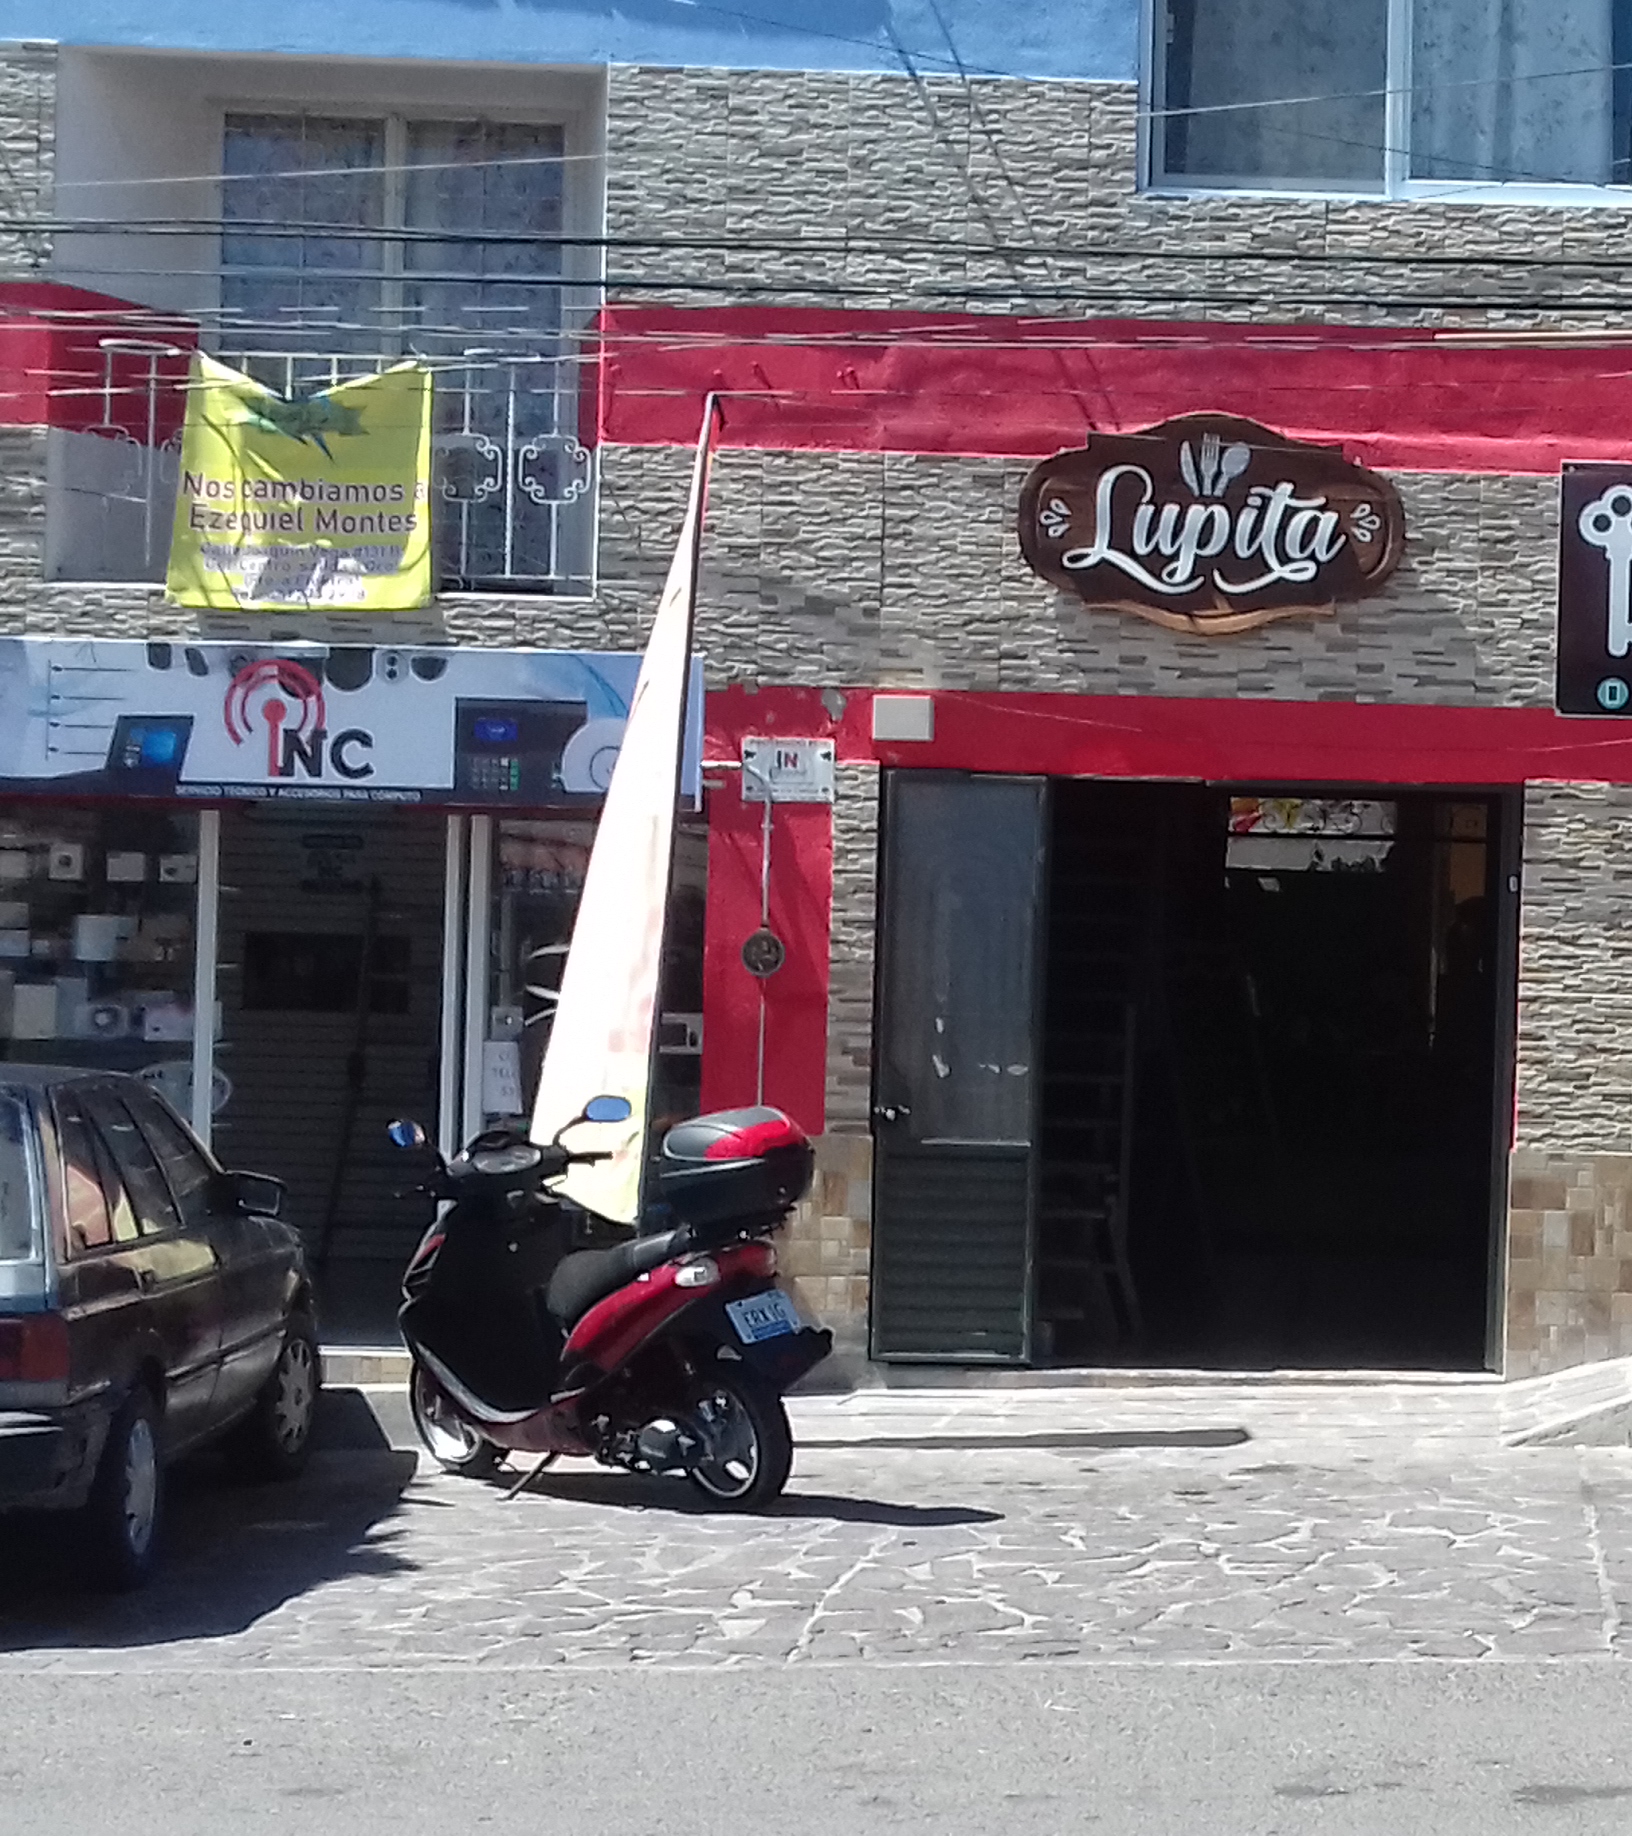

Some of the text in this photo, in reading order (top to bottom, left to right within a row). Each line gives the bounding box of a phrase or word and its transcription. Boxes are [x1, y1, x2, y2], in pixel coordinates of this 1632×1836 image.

[183, 470, 235, 499] Nos
[242, 477, 404, 502] cambiamos
[190, 503, 417, 536] Ezequiel Montes
[1062, 464, 1347, 595] Lupita
